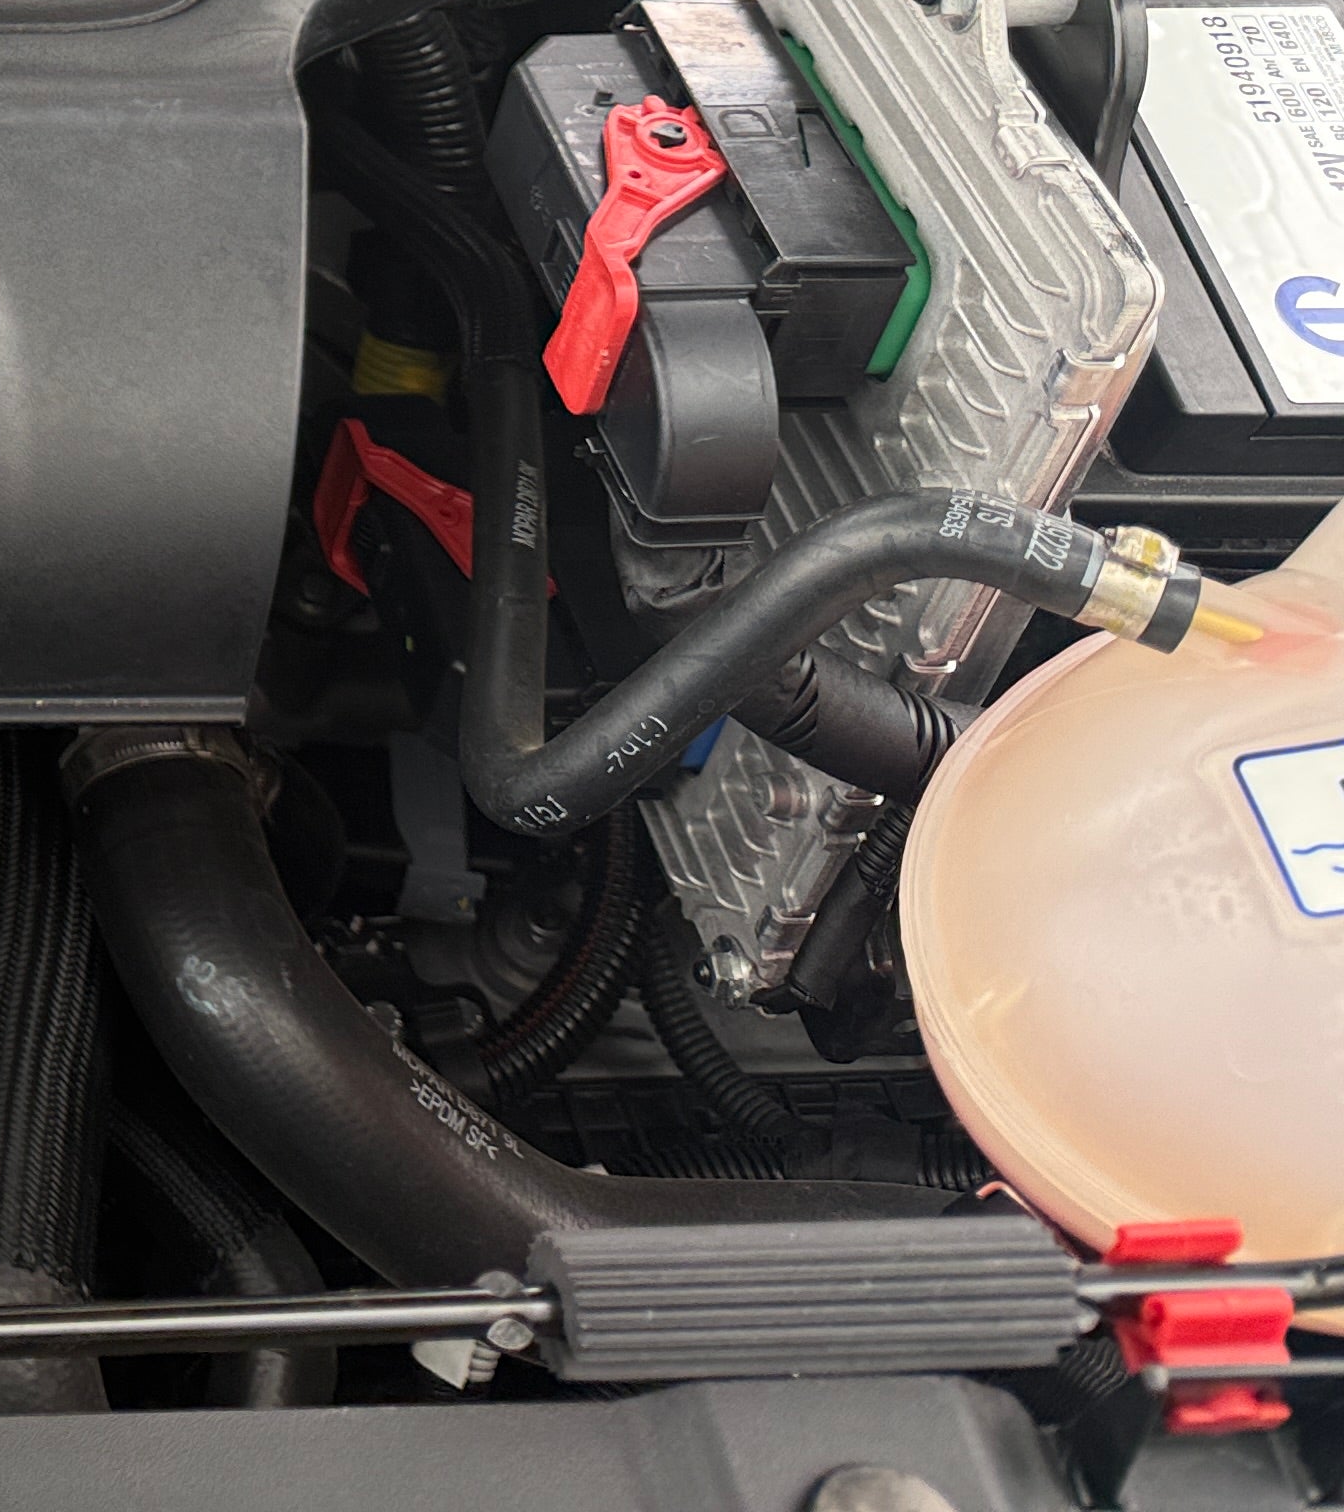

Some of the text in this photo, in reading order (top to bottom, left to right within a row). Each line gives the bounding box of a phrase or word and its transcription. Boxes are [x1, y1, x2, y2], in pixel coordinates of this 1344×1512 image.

[1241, 25, 1266, 46] 70
[1268, 20, 1300, 50] 640
[1201, 16, 1281, 123] 51940918
[1263, 58, 1284, 79] Ahr
[1290, 57, 1312, 73] EN
[1276, 87, 1308, 118] 600
[1306, 87, 1337, 118] 120
[1299, 125, 1324, 148] SAE
